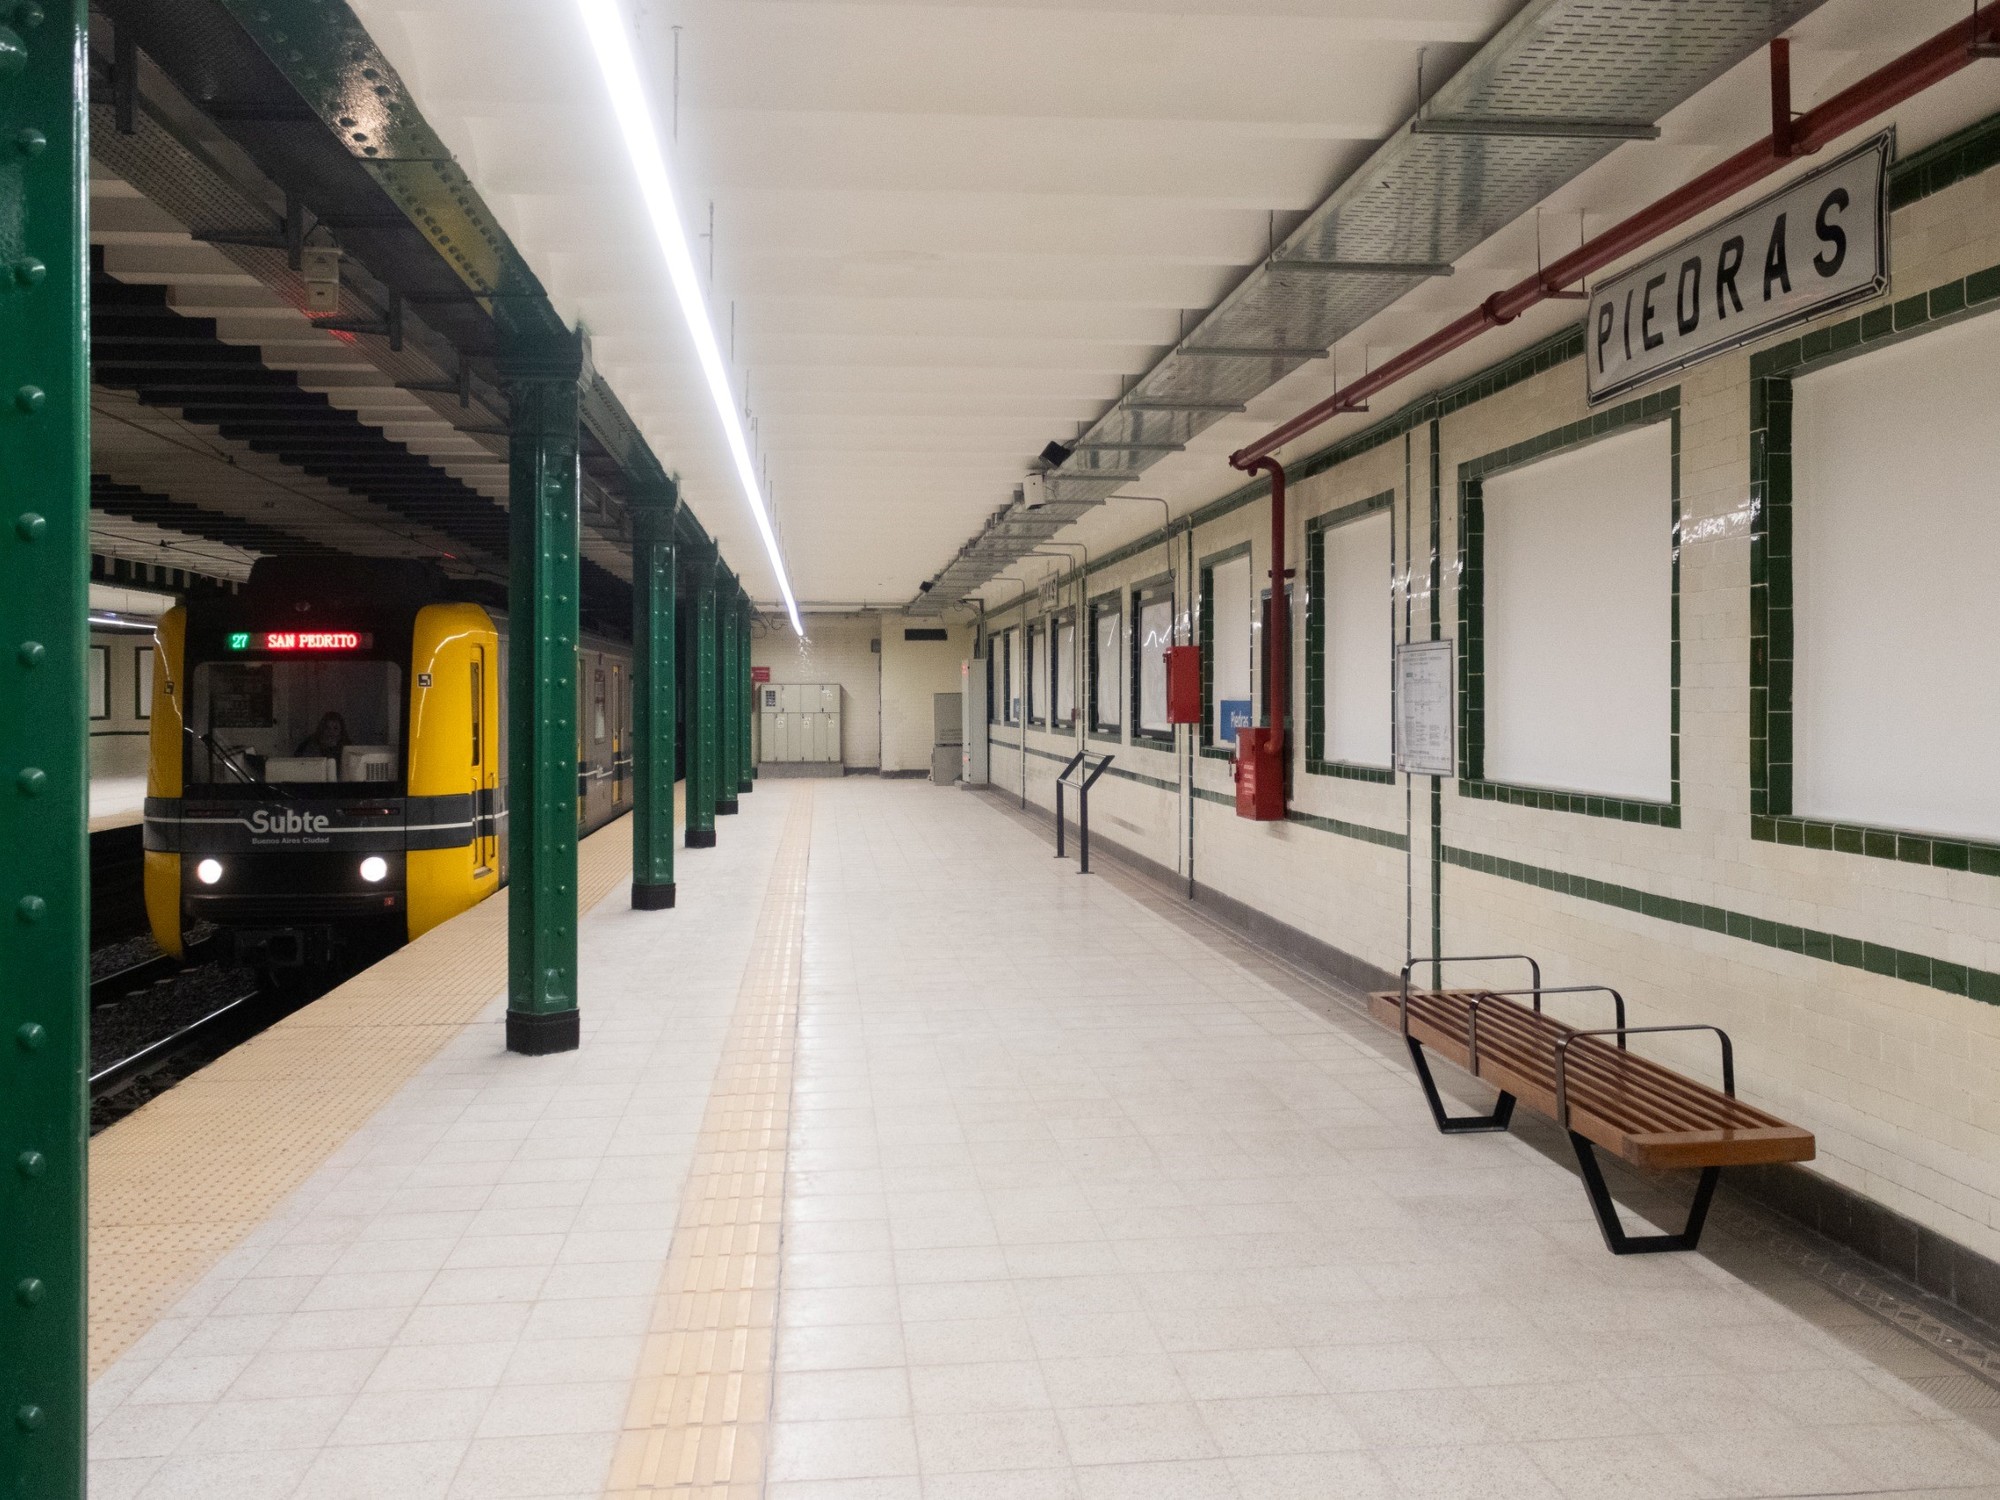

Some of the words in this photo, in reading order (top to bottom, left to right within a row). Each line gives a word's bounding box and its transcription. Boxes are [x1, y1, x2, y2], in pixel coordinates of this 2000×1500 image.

[1597, 187, 1850, 374] PIEDRAS
[232, 634, 248, 648] 27
[268, 634, 295, 648] SAN
[299, 634, 358, 648] PEDRITO
[1230, 711, 1249, 728] Piedras
[252, 809, 330, 834] Subte
[252, 837, 280, 845] Buenos
